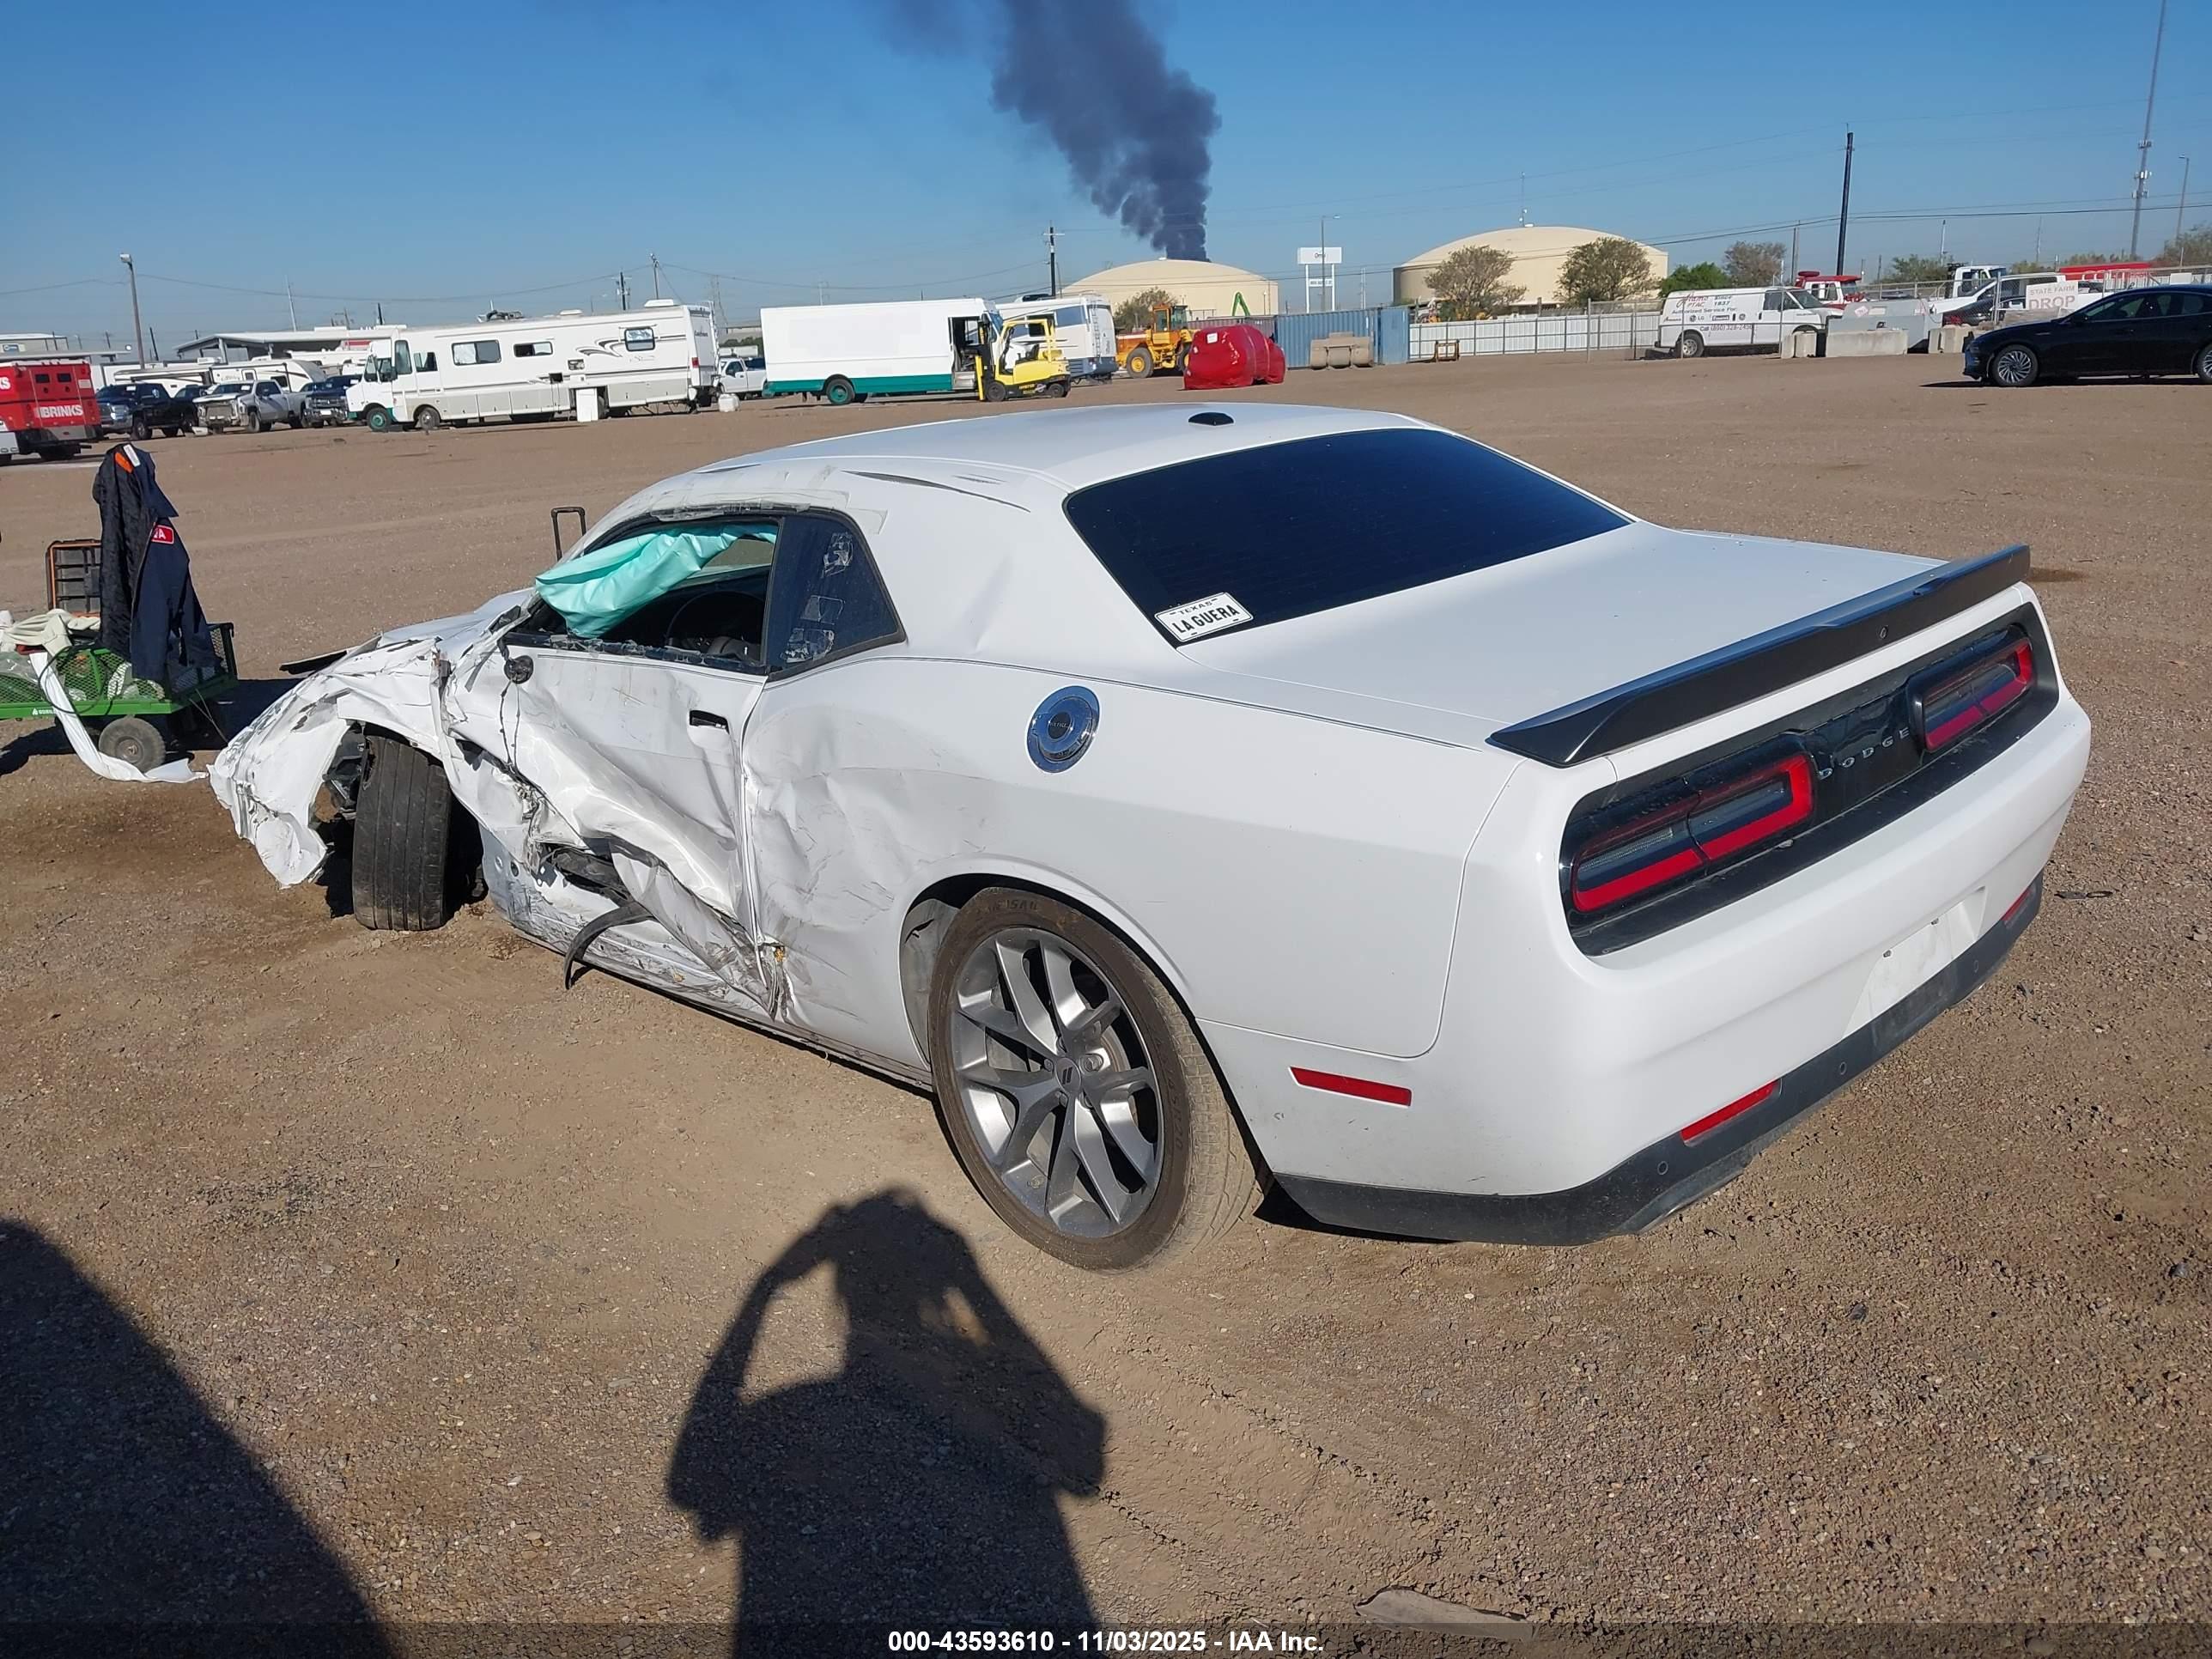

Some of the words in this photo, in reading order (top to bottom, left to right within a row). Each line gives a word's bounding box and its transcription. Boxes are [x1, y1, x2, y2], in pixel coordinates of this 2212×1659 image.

[2029, 295, 2075, 309] DROP
[40, 404, 83, 418] BRINKS
[1178, 600, 1212, 615] TEXAS
[1171, 619, 1194, 633] LA
[1190, 605, 1240, 626] GUERA
[1818, 726, 1910, 780] DODGE
